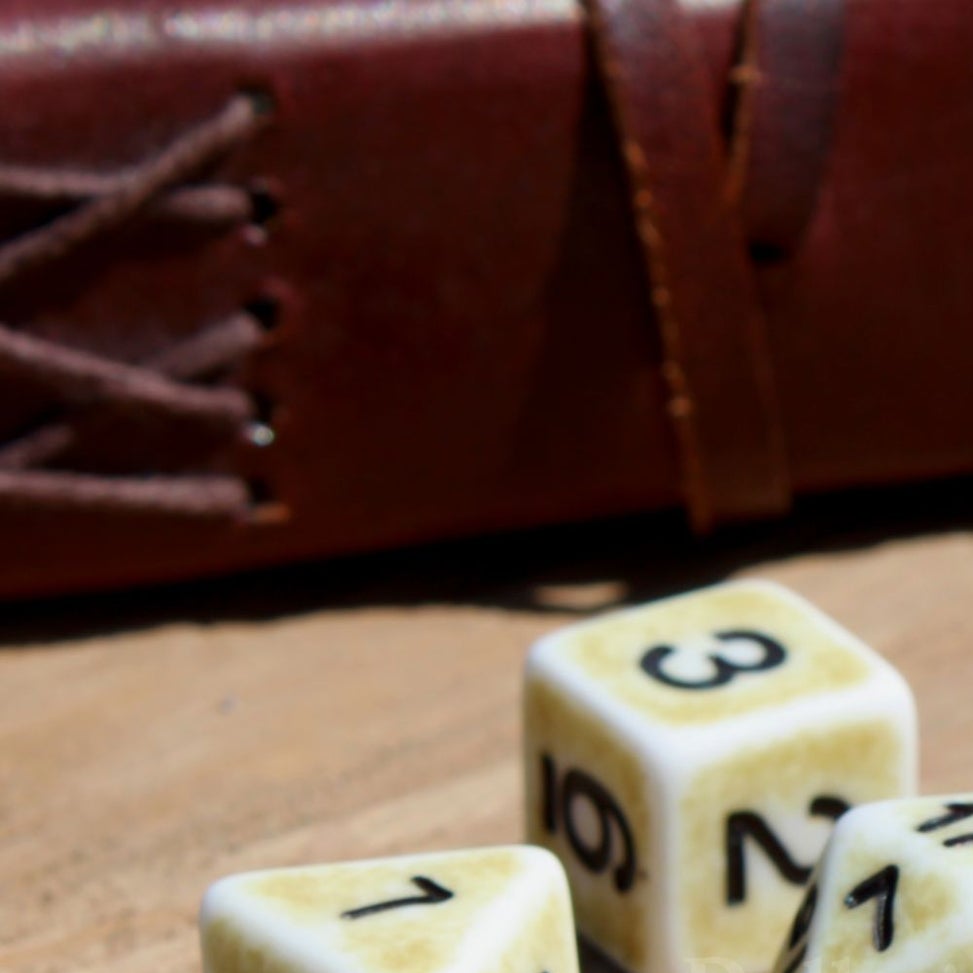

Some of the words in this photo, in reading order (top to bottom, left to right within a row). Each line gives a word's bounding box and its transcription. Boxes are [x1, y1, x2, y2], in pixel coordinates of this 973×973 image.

[642, 632, 785, 688] 3
[724, 794, 850, 906] 2
[340, 875, 454, 920] 1
